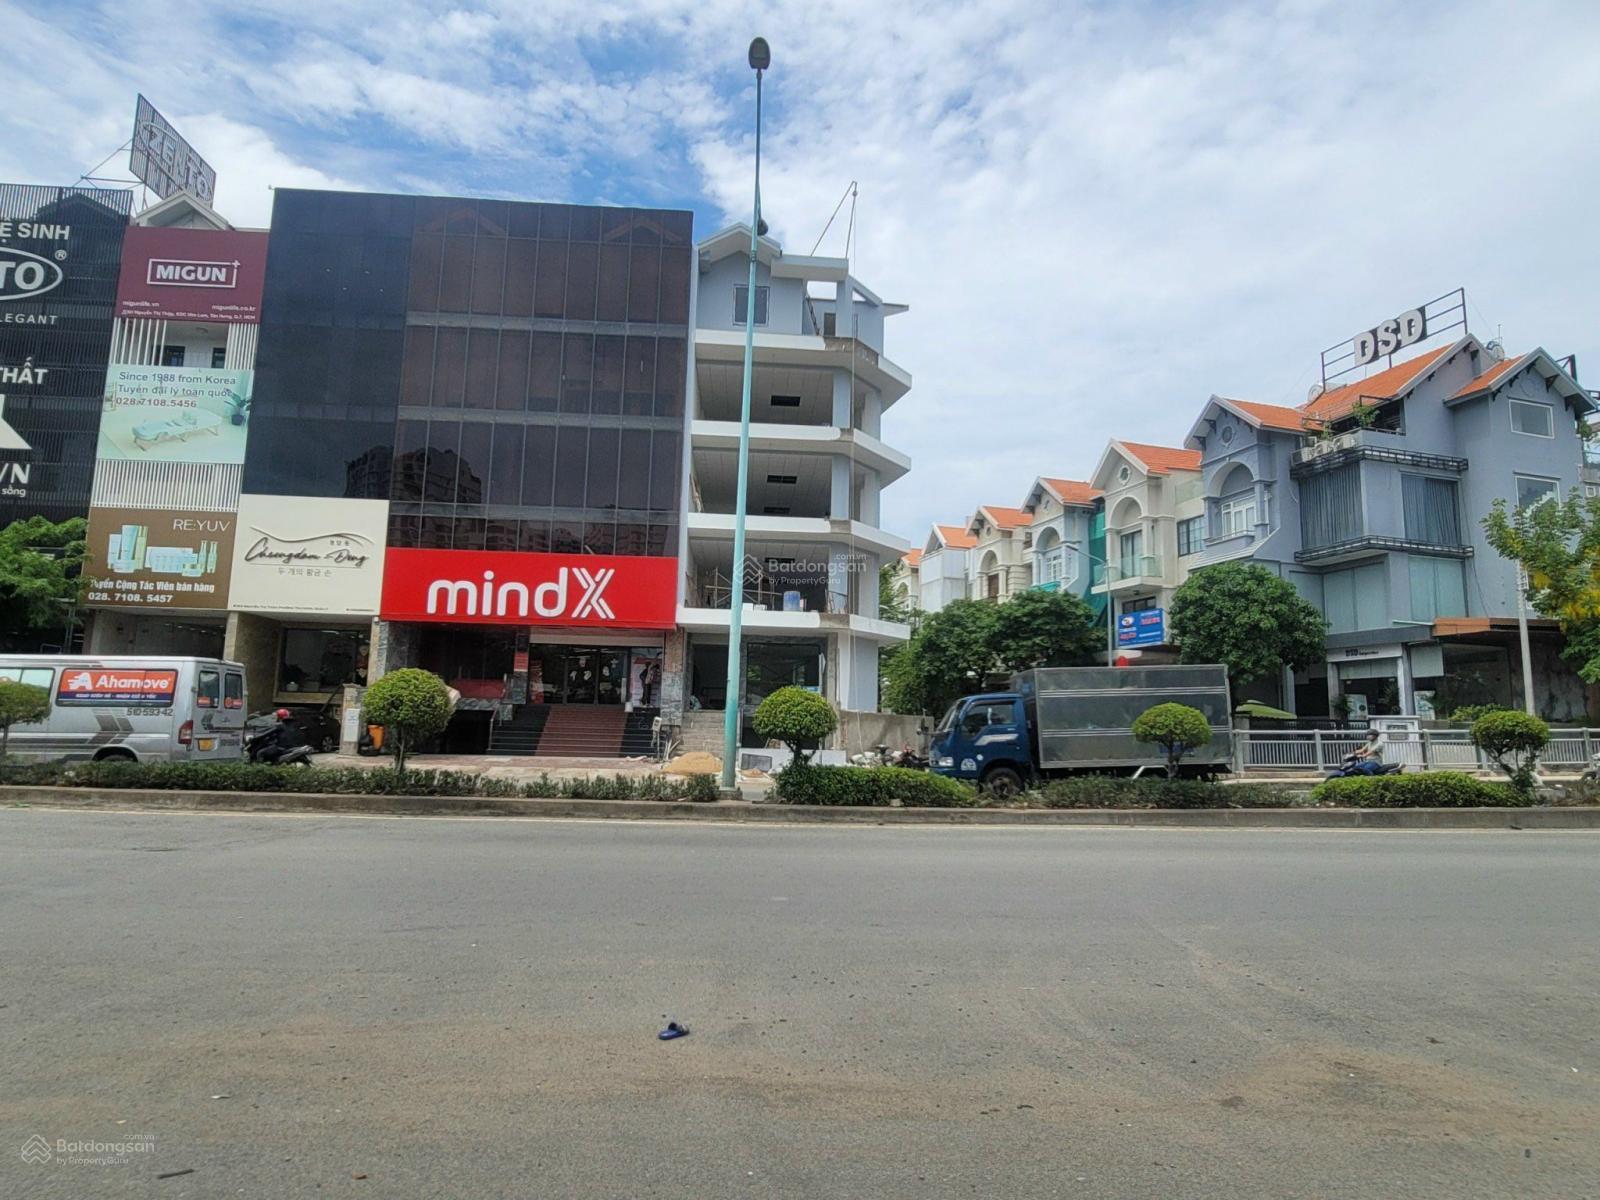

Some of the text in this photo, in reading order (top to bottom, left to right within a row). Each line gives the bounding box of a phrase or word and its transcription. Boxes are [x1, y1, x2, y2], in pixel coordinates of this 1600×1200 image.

[17, 222, 70, 240] SINH
[156, 264, 227, 282] MIGUN
[0, 312, 58, 325] EGANT
[1353, 308, 1424, 368] DSD
[0, 356, 49, 385] HẤT
[119, 371, 236, 385] Since 1988 from Korea
[88, 592, 173, 603] 028. 7108. 5457
[427, 566, 616, 619] mindX
[95, 674, 169, 689] Ahamove
